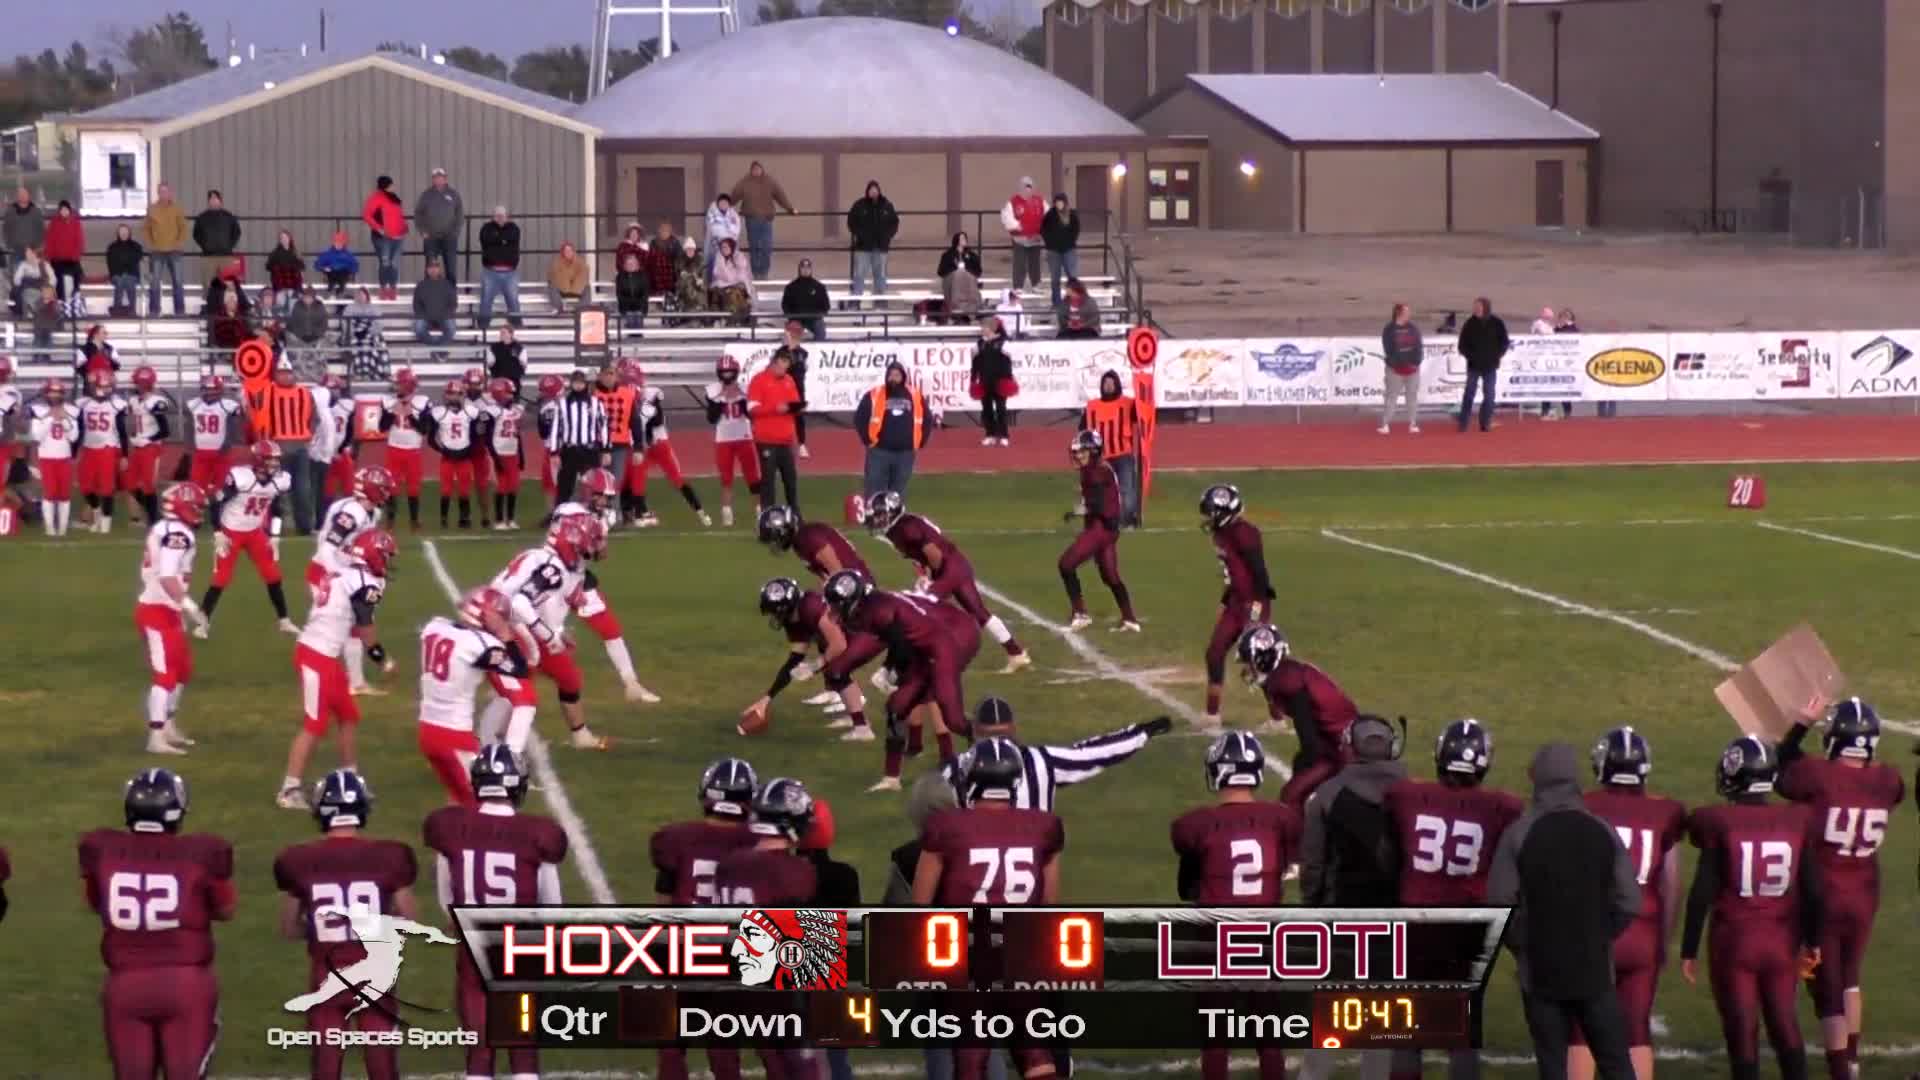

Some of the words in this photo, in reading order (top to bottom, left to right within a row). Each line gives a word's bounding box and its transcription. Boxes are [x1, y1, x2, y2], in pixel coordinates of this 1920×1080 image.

[819, 350, 897, 369] Nutrien
[932, 370, 969, 393] SUPP
[1594, 358, 1657, 376] HELENA
[1849, 377, 1918, 394] ADM
[853, 495, 866, 523] 3
[1730, 478, 1753, 505] 20
[423, 634, 455, 682] 18
[1413, 814, 1484, 876] 33
[1824, 807, 1888, 857] 45
[463, 849, 517, 904] 15
[969, 847, 1036, 904] 76
[1230, 839, 1263, 895] 2
[1740, 841, 1792, 897] 13
[109, 872, 180, 931] 62
